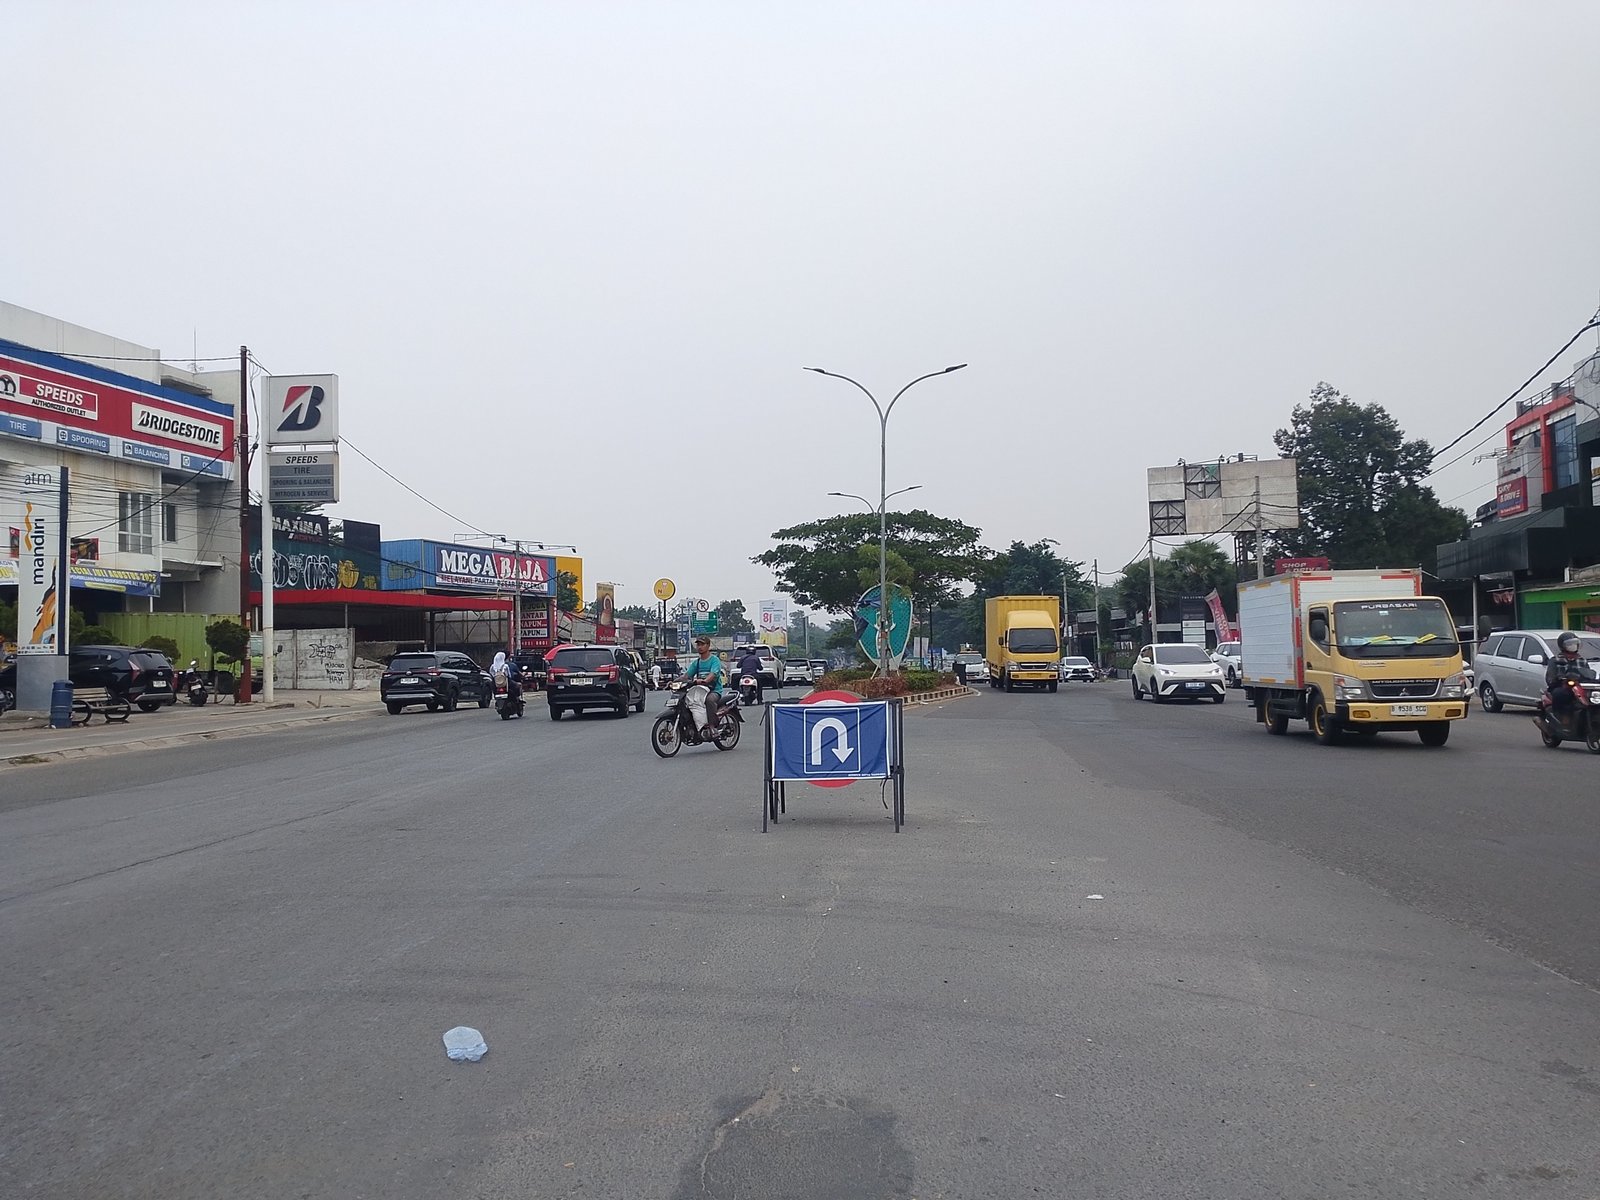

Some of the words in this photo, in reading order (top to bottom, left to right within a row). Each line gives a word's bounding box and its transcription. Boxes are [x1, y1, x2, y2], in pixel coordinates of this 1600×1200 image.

[36, 384, 83, 406] SPEEDS
[32, 398, 66, 412] AUTHORIZED
[67, 405, 86, 416] OUTLET
[9, 420, 27, 432] TIRE
[138, 410, 220, 445] BRIDGESTONE
[71, 434, 107, 448] SPOORING
[134, 447, 169, 461] BALANCING
[285, 456, 318, 464] SPEEDS
[24, 472, 52, 486] atm
[31, 518, 45, 585] mandiri
[441, 549, 496, 577] MEGA
[500, 557, 544, 581] BAJA
